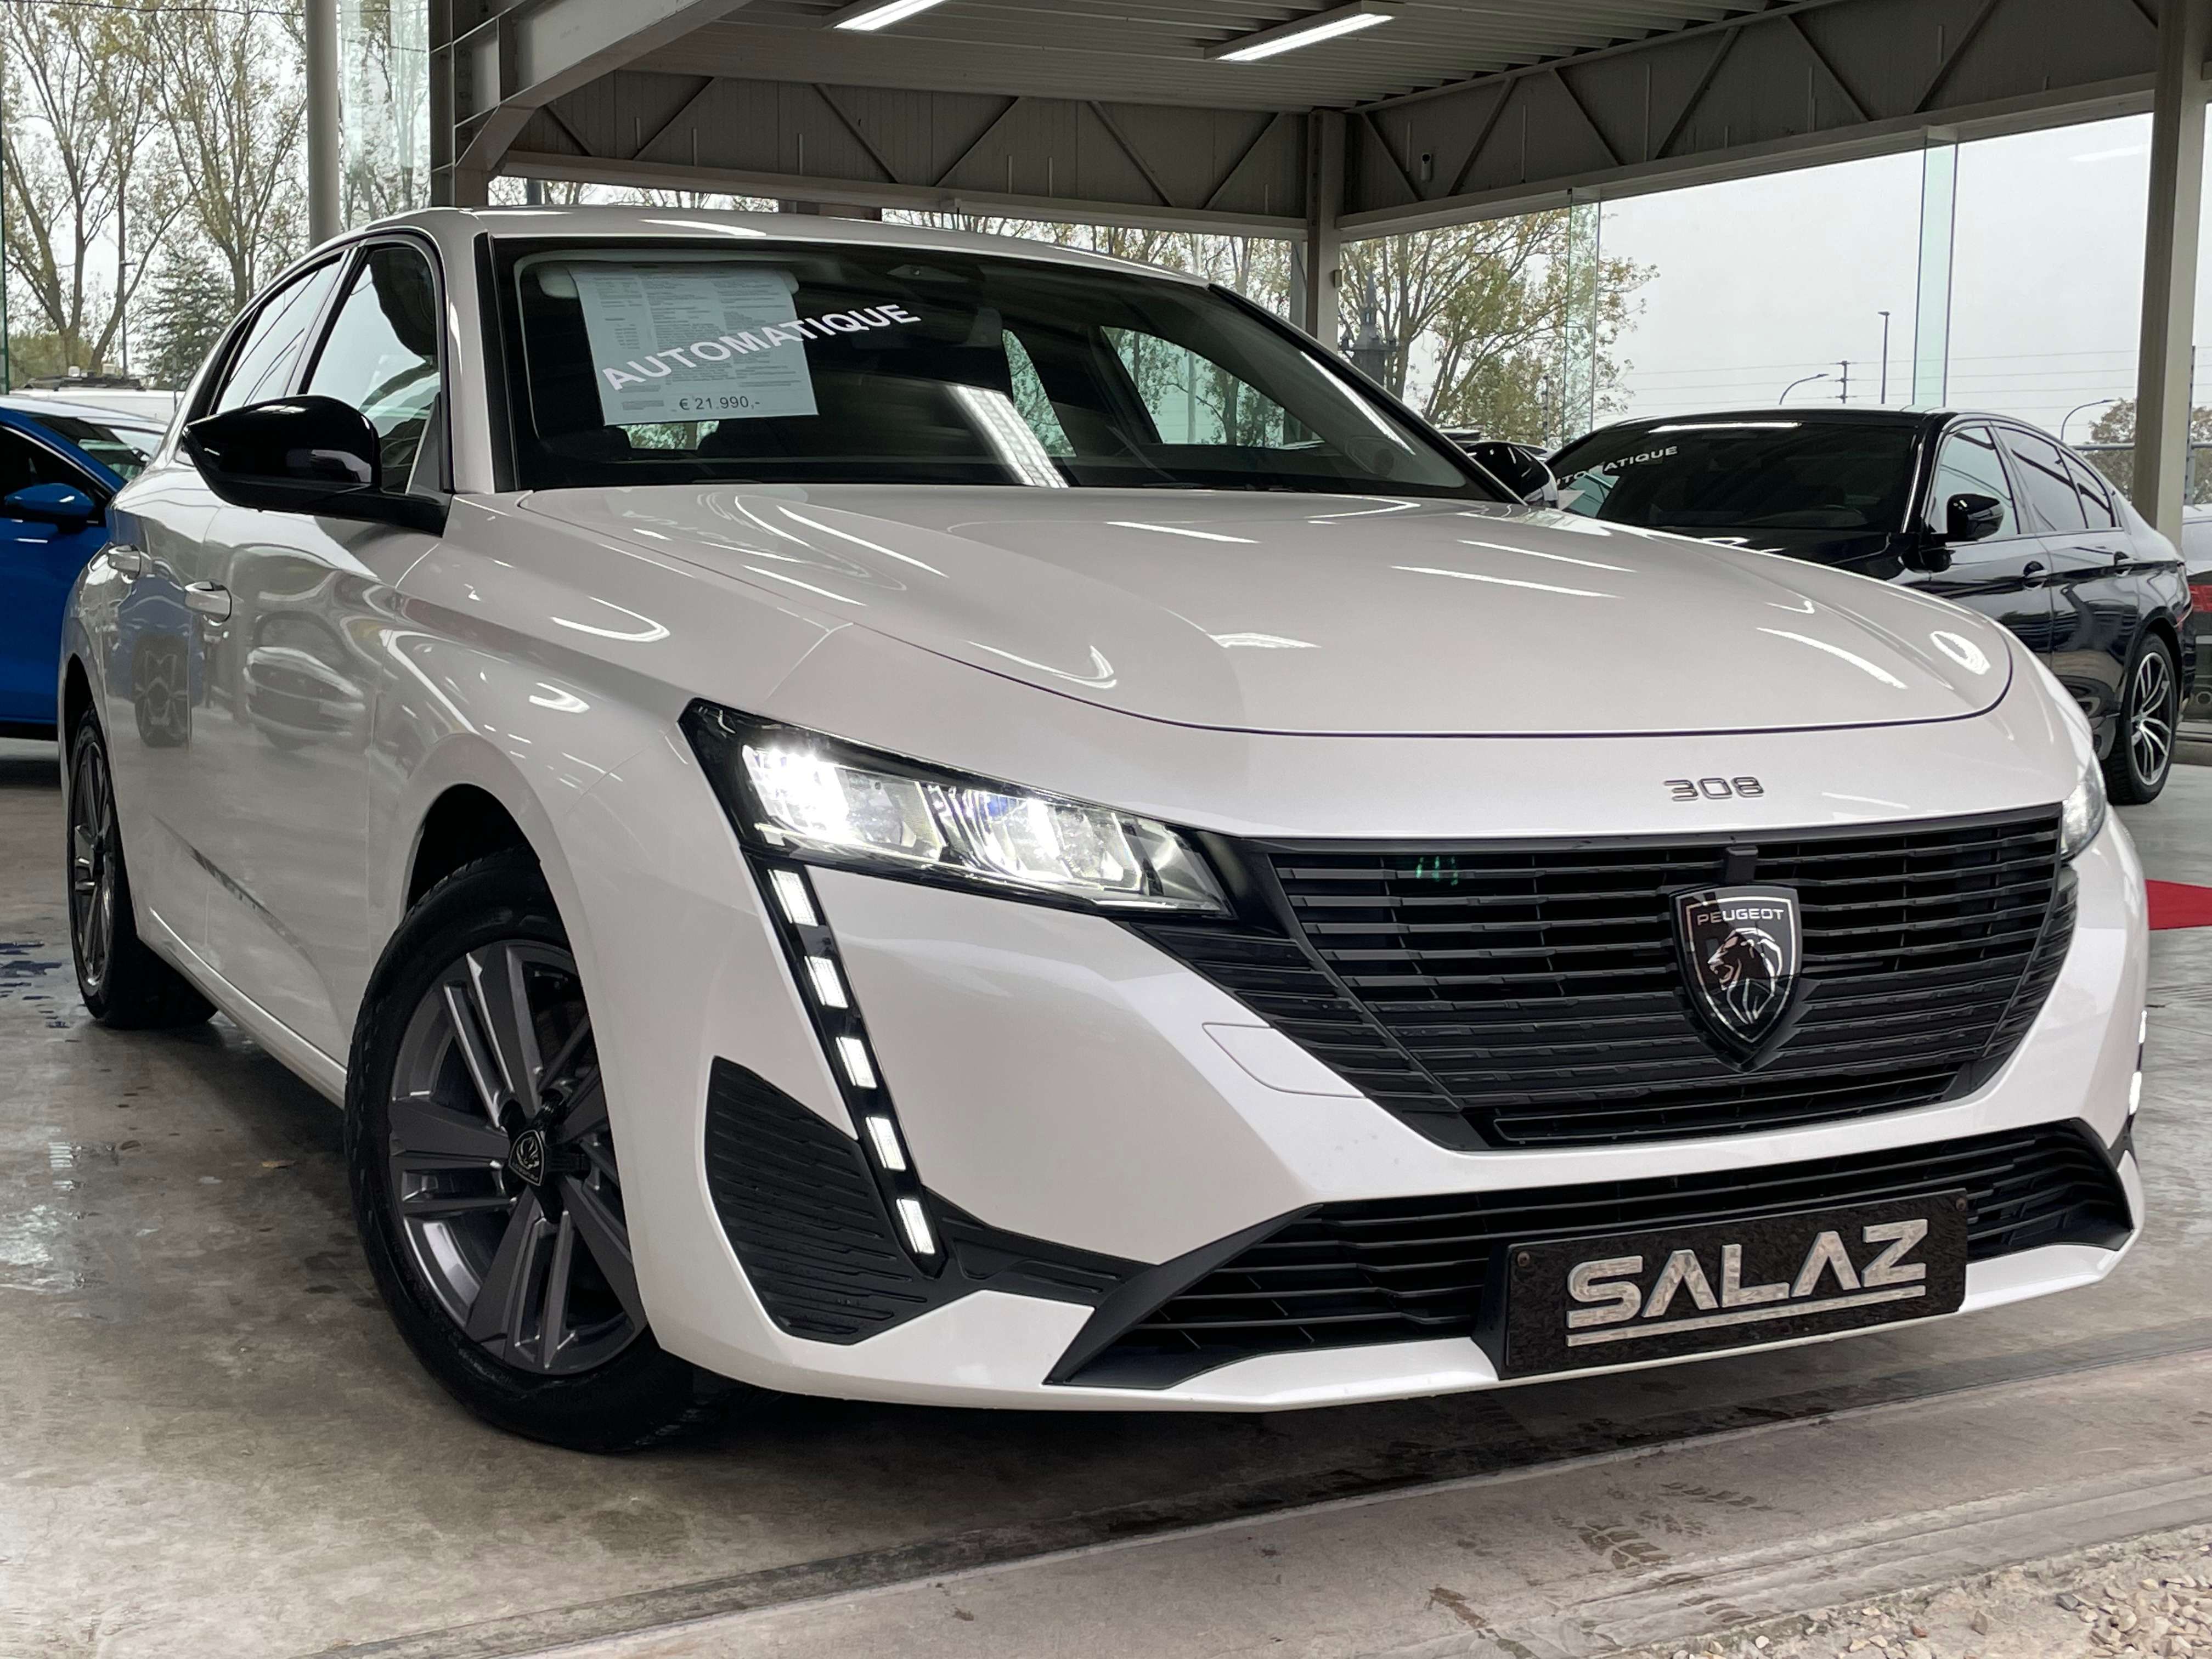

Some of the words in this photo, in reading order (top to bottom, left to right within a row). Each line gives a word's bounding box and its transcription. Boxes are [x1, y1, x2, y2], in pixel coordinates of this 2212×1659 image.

[602, 304, 922, 391] AUTOMATIQUE
[679, 398, 690, 410] €
[695, 396, 760, 410] 21.990,-
[1663, 777, 1764, 802] 308
[1697, 908, 1784, 926] PEUGEOT
[1567, 1218, 1928, 1329] SALAZ
